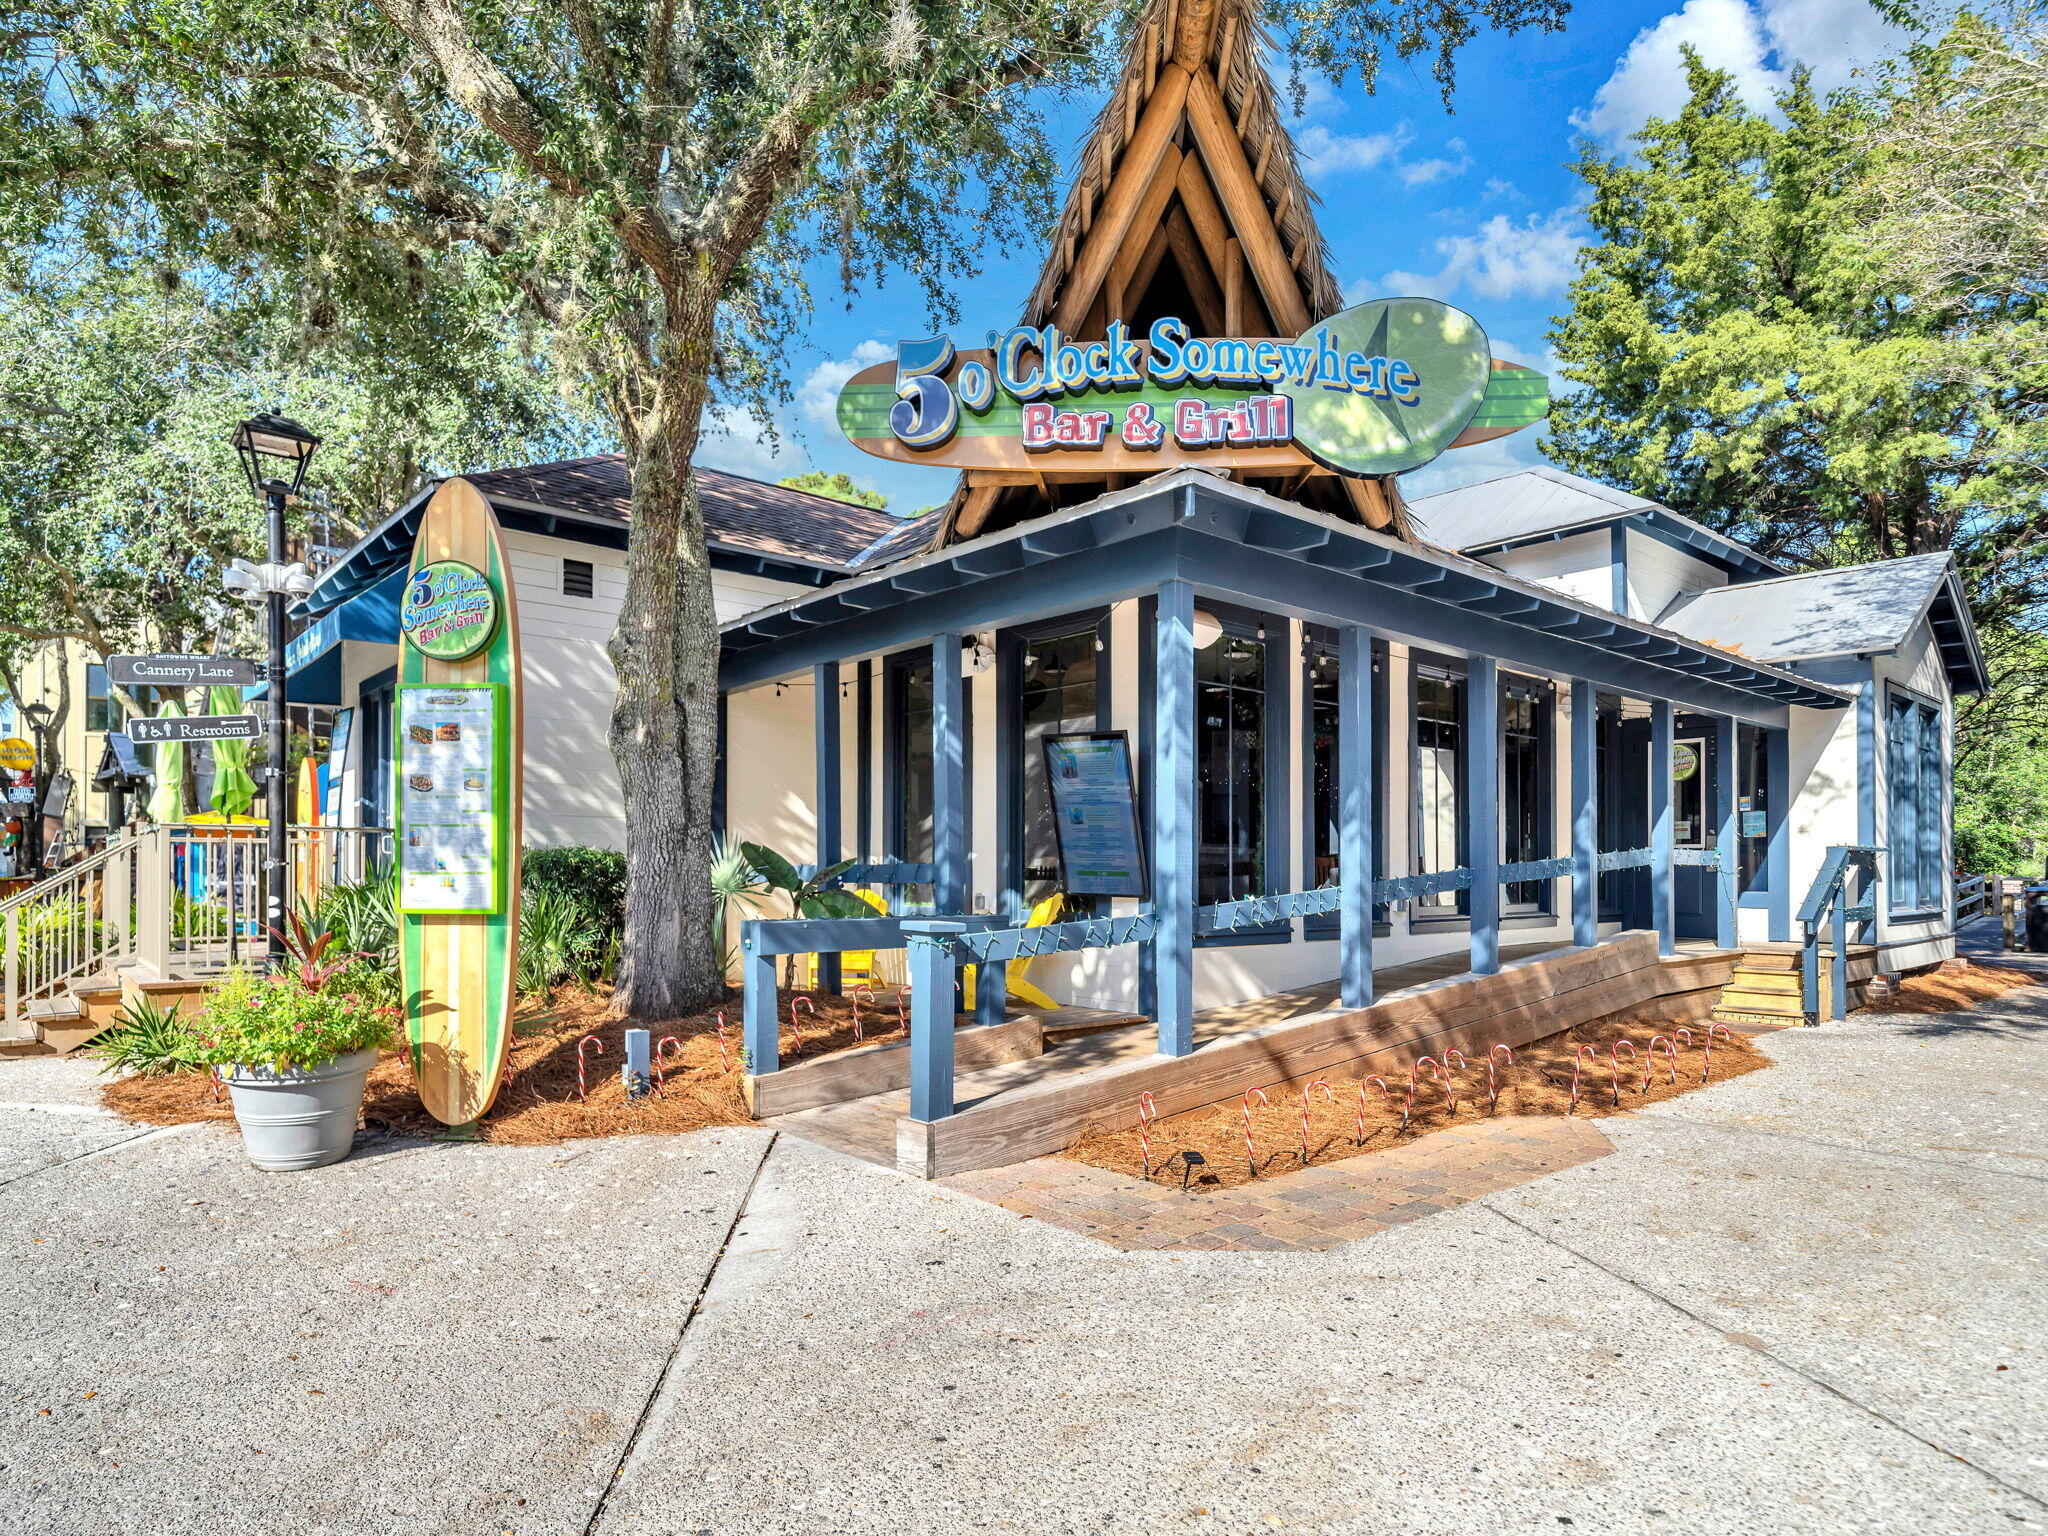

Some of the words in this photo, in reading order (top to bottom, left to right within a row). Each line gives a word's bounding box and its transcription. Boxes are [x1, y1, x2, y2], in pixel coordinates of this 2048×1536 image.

[889, 333, 957, 447] 5
[1147, 316, 1421, 407] Somewhere
[1022, 402, 1112, 450] Bar
[1122, 401, 1166, 448] &
[1174, 394, 1293, 447] Grill
[412, 570, 434, 607] 5
[403, 594, 490, 632] Somewhere
[418, 626, 441, 646] Bar
[443, 619, 454, 633] &
[456, 611, 484, 629] Grill
[132, 661, 196, 681] Cannery
[199, 663, 234, 677] Lane
[179, 723, 251, 737] Restrooms
